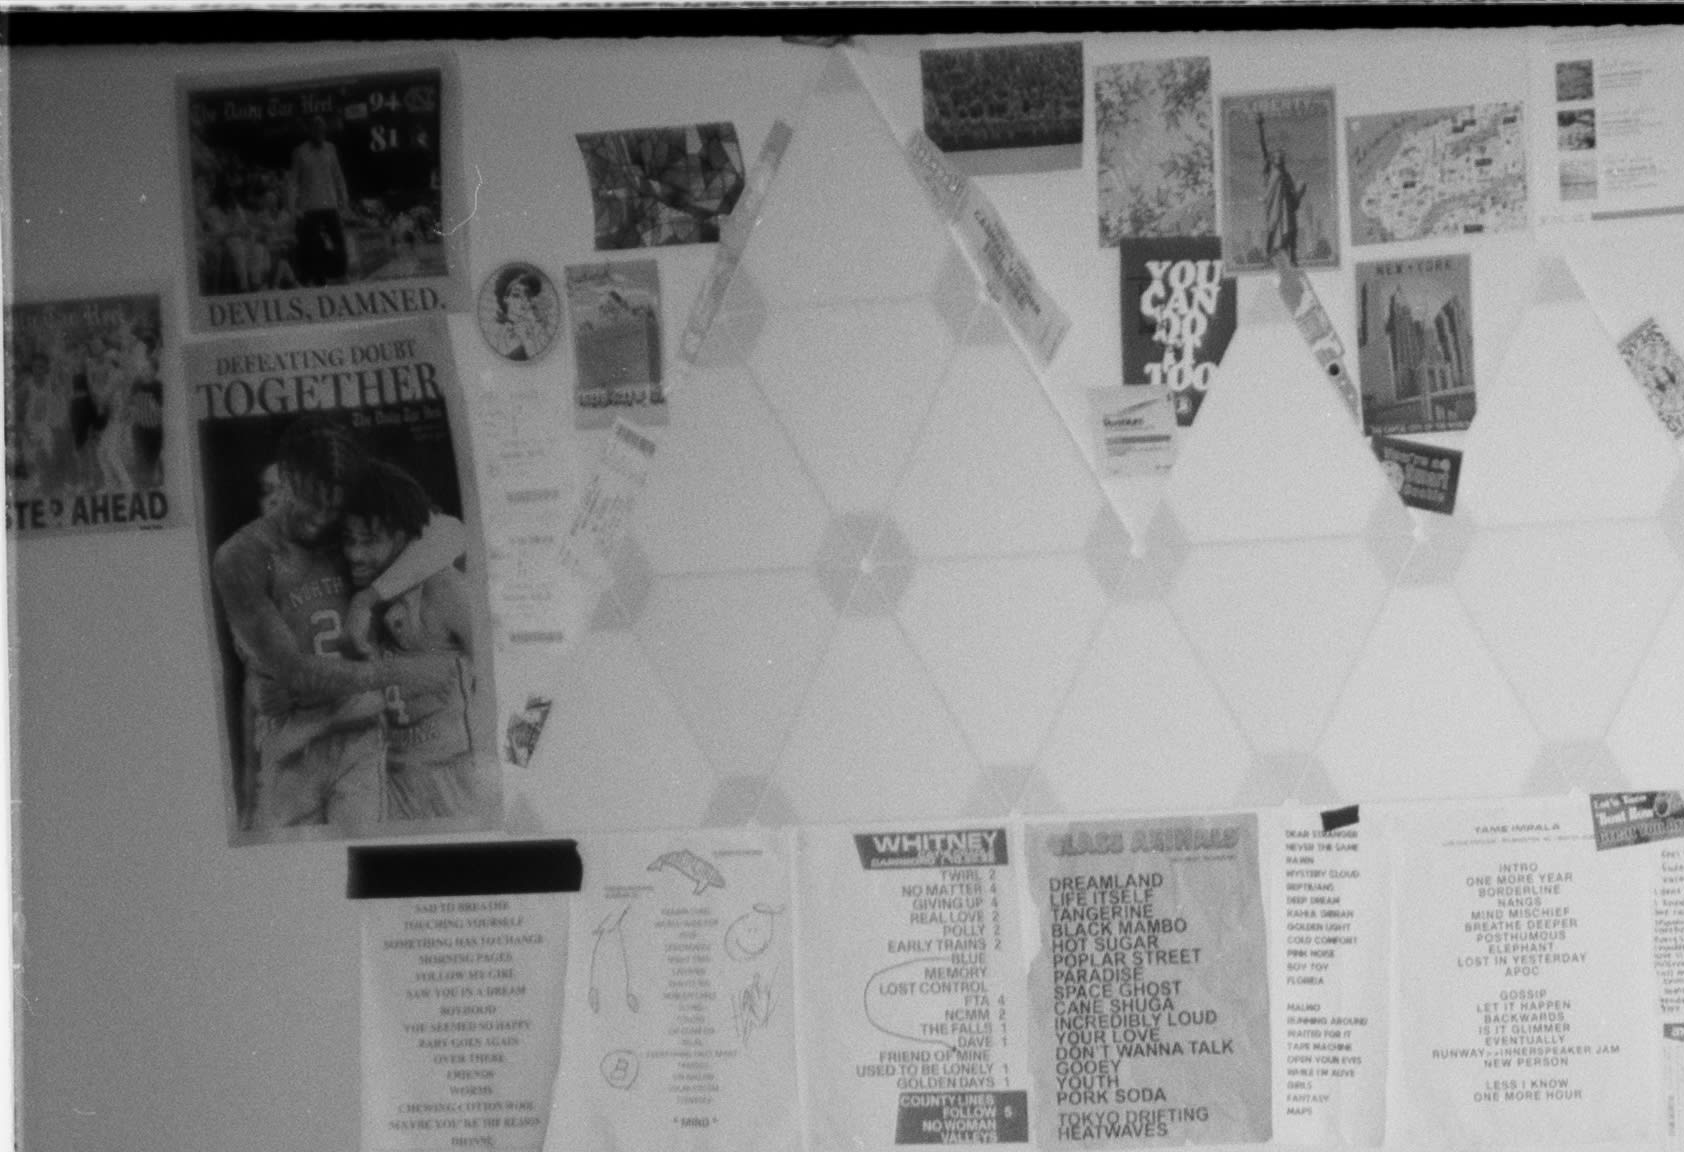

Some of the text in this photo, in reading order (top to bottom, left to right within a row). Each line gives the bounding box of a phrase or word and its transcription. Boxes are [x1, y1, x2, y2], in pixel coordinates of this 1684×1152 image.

[369, 124, 398, 153] 81
[1146, 260, 1222, 289] YOU
[207, 286, 447, 328] DEVILS, DAMNED.
[1141, 285, 1221, 317] CAN
[1154, 309, 1208, 344] DO
[216, 339, 417, 377] DEFEATING DOUBT
[1144, 362, 1219, 391] TOO
[196, 362, 445, 419] TOGETHER
[71, 491, 169, 527] AHEAD
[310, 610, 342, 657] 2
[1474, 823, 1560, 835] TAME IMPALA
[872, 831, 998, 853] WHITNEY
[941, 869, 983, 881] TWIRL
[1499, 862, 1539, 873] INTRO
[1049, 872, 1164, 892] DREAMLAND
[1465, 872, 1573, 887] ONE MORE YEAR
[901, 883, 983, 897] NO MATTER
[1478, 884, 1561, 898] BORDERLINE
[912, 897, 984, 910] GIVING UP
[1050, 888, 1154, 908] LIFE ITSELF
[1497, 897, 1542, 908] NANGS
[910, 910, 1000, 925] REAL LOVE 2
[1051, 903, 1154, 923] TANGERINE
[1470, 907, 1570, 920] MIND MISCHIEF
[943, 925, 1001, 937] POLLY 2
[1051, 917, 1188, 938] BLACK MAMBO
[1464, 918, 1579, 933] BREATHE DEEPER
[1052, 934, 1159, 954] HOT SUGAR
[1476, 930, 1567, 943] POSTHUMOUS
[887, 938, 987, 953] EARLY TRAINS
[1488, 942, 1554, 954] ELEPHANT
[951, 953, 986, 964] BLUE
[1053, 947, 1202, 969] POPLAR STREET
[1457, 952, 1587, 968] LOST IN YESTERDAY
[924, 966, 987, 980] MEMORY
[1053, 966, 1144, 985] PARADISE
[1504, 966, 1540, 977] APOC
[879, 981, 989, 996] LOST CONTROL
[1053, 980, 1182, 1000] SPACE GHOST
[1499, 989, 1547, 1001] GOSSIP
[964, 995, 990, 1006] FTA
[1054, 997, 1175, 1017] CANE SHUGA
[945, 1008, 1006, 1021] NCMM 2
[1054, 1009, 1218, 1031] INCREDIBLY LOUD
[1484, 1012, 1565, 1024] BACKWARDS
[920, 1022, 993, 1035] THE FALLS
[958, 1036, 992, 1048] DAVE
[1055, 1027, 1161, 1046] YOUR LOVE
[1484, 1035, 1566, 1047] EVENTUALLY
[1116, 1041, 1185, 1058] WANNA
[1188, 1038, 1235, 1056] TALK
[879, 1050, 991, 1063] FRIEND OF MINE
[855, 1062, 994, 1078] USED TO BE LONELY
[1055, 1059, 1122, 1076] GOOEY
[897, 1076, 995, 1089] GOLDEN DAYS
[1056, 1075, 1120, 1091] YOUTH
[900, 1094, 995, 1107] COUNTY LINES
[1056, 1087, 1167, 1106] PORK SODA
[942, 1106, 997, 1119] FOLLOW
[1058, 1106, 1210, 1127] TOKYO DRIFTING
[922, 1119, 998, 1131] NO WOMAN
[1057, 1122, 1168, 1141] HEATWAVES
[940, 1132, 998, 1144] VALLEYS
